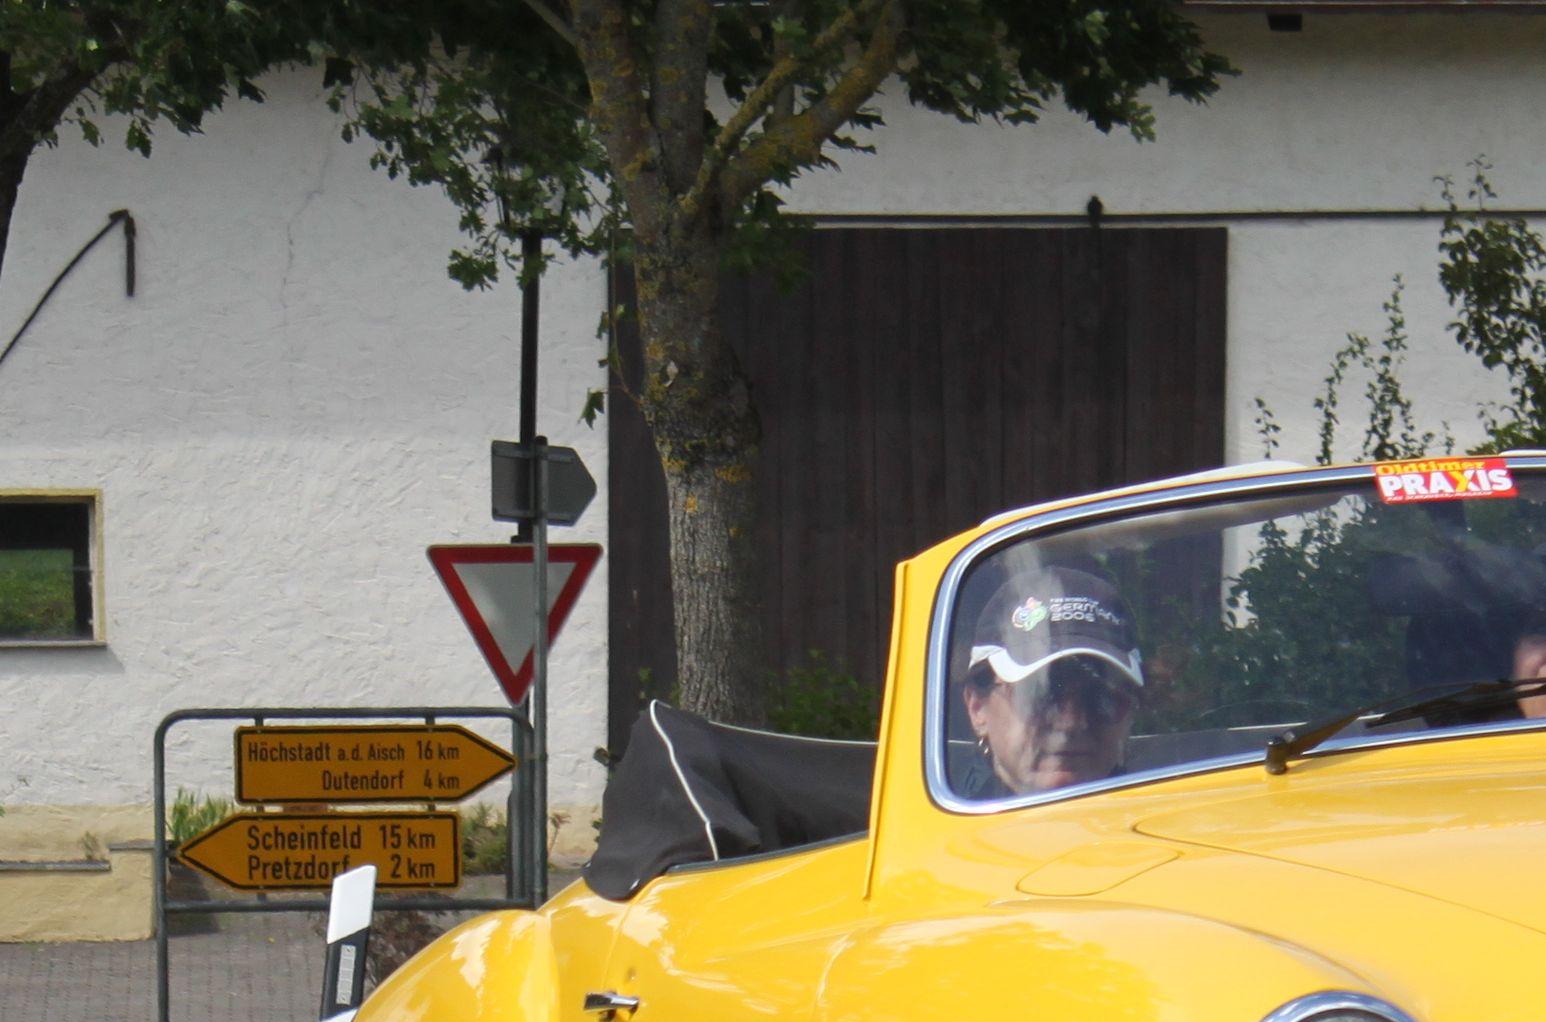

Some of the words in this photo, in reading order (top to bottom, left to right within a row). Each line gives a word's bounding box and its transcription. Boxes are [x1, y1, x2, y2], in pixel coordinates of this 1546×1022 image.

[1375, 461, 1485, 475] Oldtimer
[1379, 469, 1513, 498] PRAXIS
[1051, 611, 1095, 622] 2006
[248, 741, 331, 762] Höchstadt
[368, 743, 405, 761] Aisch
[417, 741, 433, 760] 16
[437, 741, 460, 760] km
[322, 770, 405, 791] Dutendorf
[423, 770, 433, 789] 4
[437, 770, 460, 790] km
[247, 825, 362, 851] Scheinfeld
[379, 825, 401, 849] 15
[407, 828, 436, 849] km
[248, 855, 350, 880] Pretzdorf
[390, 854, 402, 879] 2
[407, 855, 436, 878] km
